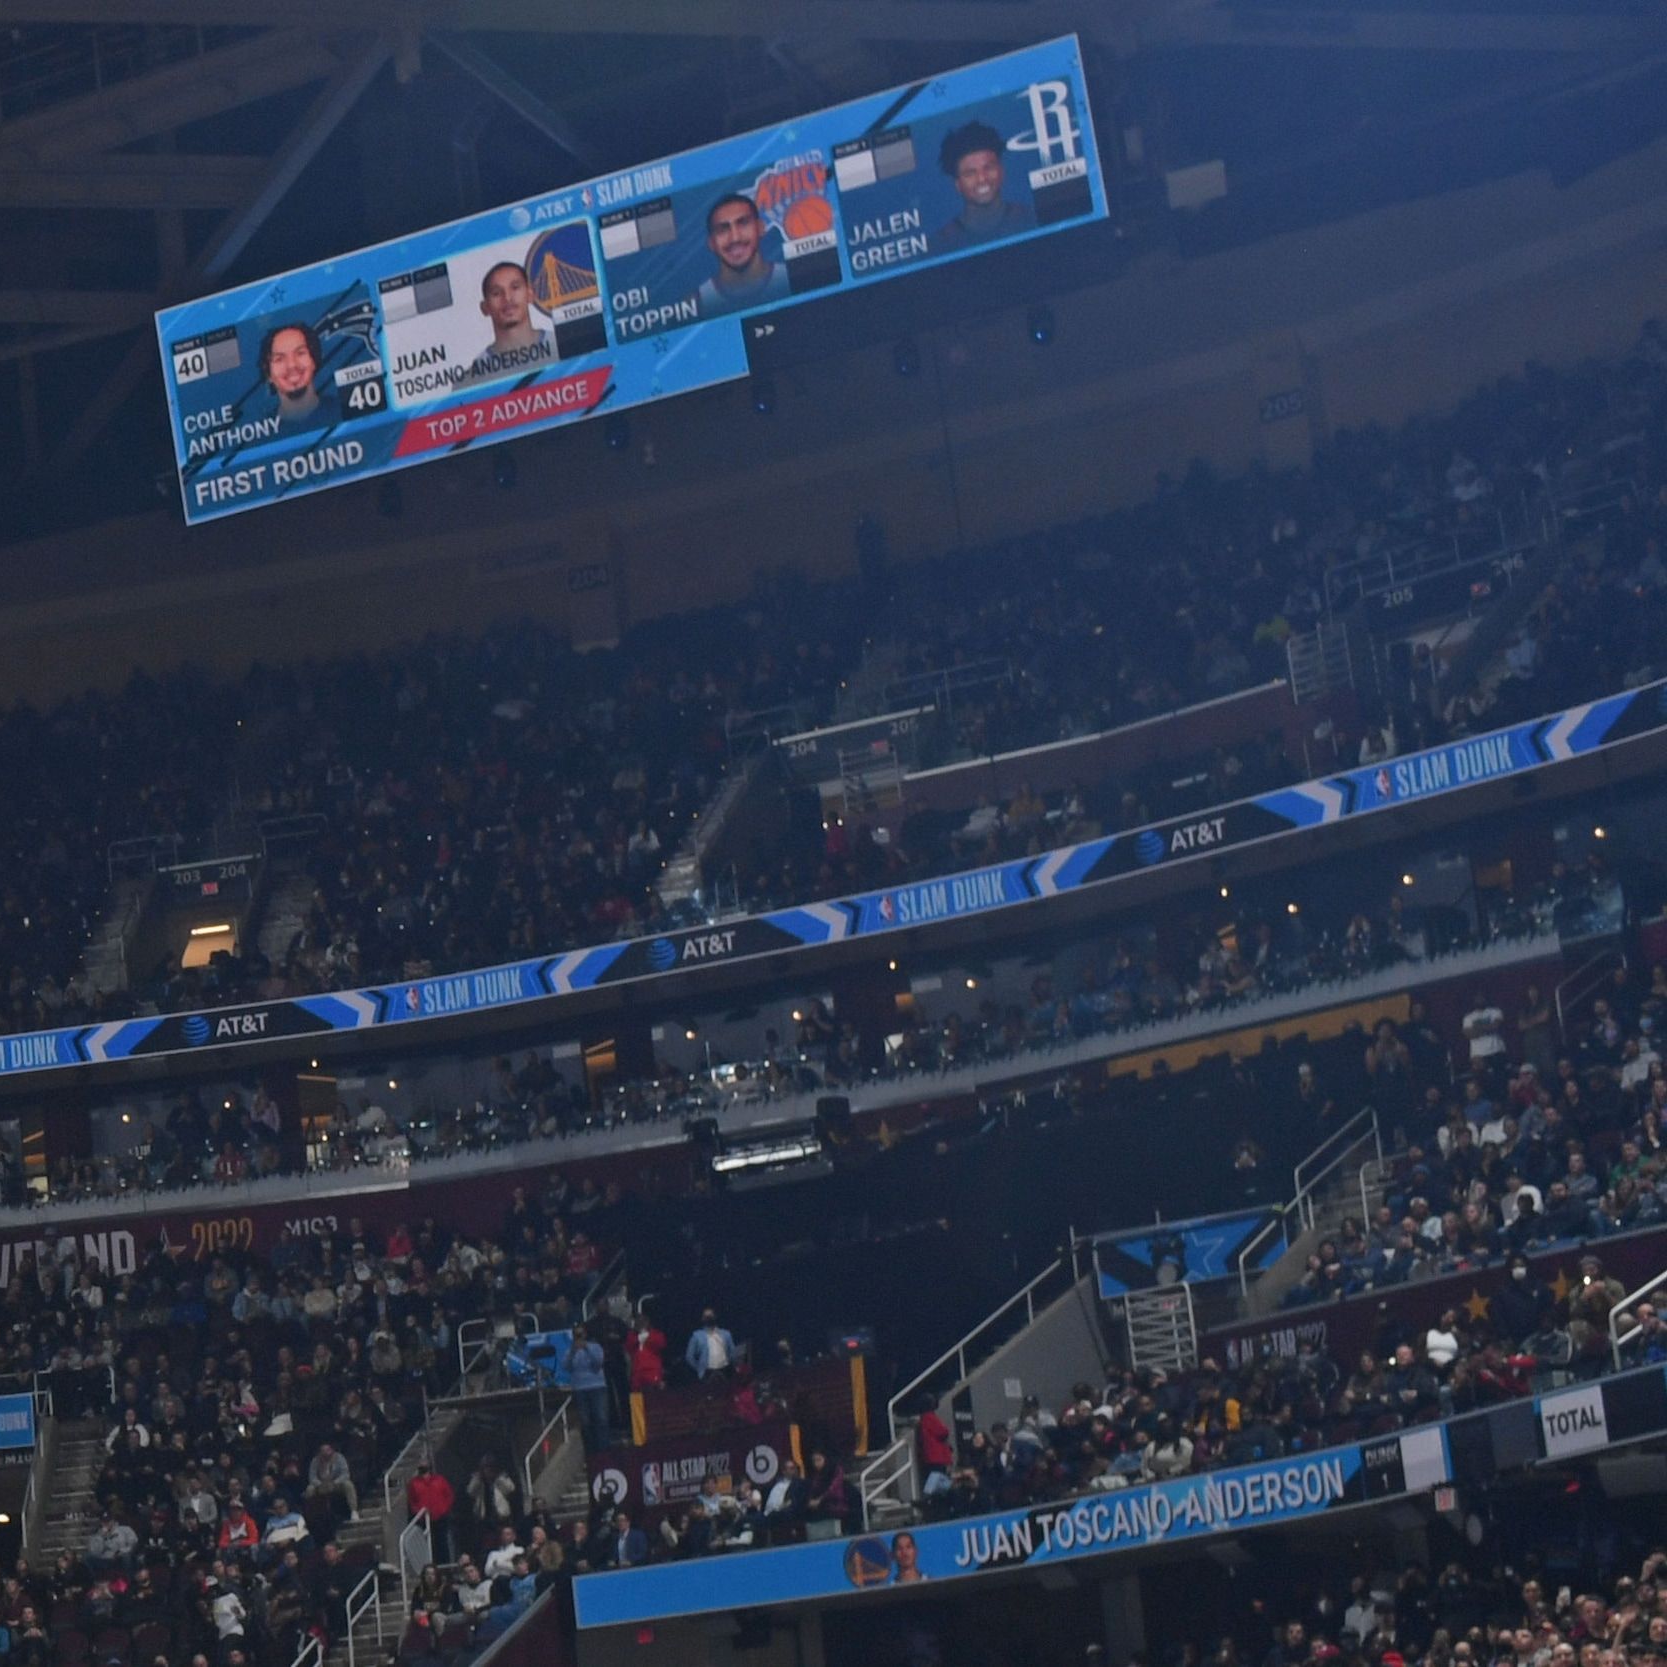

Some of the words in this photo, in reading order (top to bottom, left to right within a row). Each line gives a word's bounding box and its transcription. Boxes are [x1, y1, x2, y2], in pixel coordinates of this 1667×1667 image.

[597, 179, 633, 207] SLAM
[634, 164, 673, 190] DUNK
[535, 198, 573, 222] AT&T
[849, 208, 921, 246] JALEN
[852, 233, 928, 272] GREEN
[613, 286, 649, 312] OBI
[616, 299, 698, 337] TOPPIN
[178, 354, 204, 377] 40
[344, 366, 377, 382] TOTAL
[393, 345, 446, 375] JUAN
[395, 341, 551, 399] TOSCANO-ANDERSON
[349, 381, 381, 410] 40
[427, 414, 466, 440] TOP
[473, 409, 485, 427] 2
[491, 381, 588, 422] ADVANCE
[183, 405, 233, 433] COLE
[188, 416, 281, 457] ANTHONY
[195, 466, 266, 506] FIRST
[273, 441, 363, 485] ROUND
[1397, 752, 1450, 797] SLAM
[1455, 735, 1513, 783] DUNK
[1171, 818, 1225, 852] AT&T
[174, 870, 202, 885] 203
[219, 863, 247, 879] 204
[899, 884, 948, 922] SLAM
[953, 872, 1004, 909] DUNK
[683, 931, 736, 960] AT&T
[424, 979, 469, 1013] SLAM
[474, 968, 522, 1004] DUNK
[217, 1013, 269, 1037] AT&T
[11, 1036, 59, 1069] DUNK
[0, 1410, 29, 1432] DUNK
[1546, 1402, 1603, 1439] TOTAL
[1366, 1446, 1398, 1466] DUNK
[955, 1522, 1033, 1567] JUAN
[1035, 1459, 1345, 1553] TOSCANO-ANDERSON
